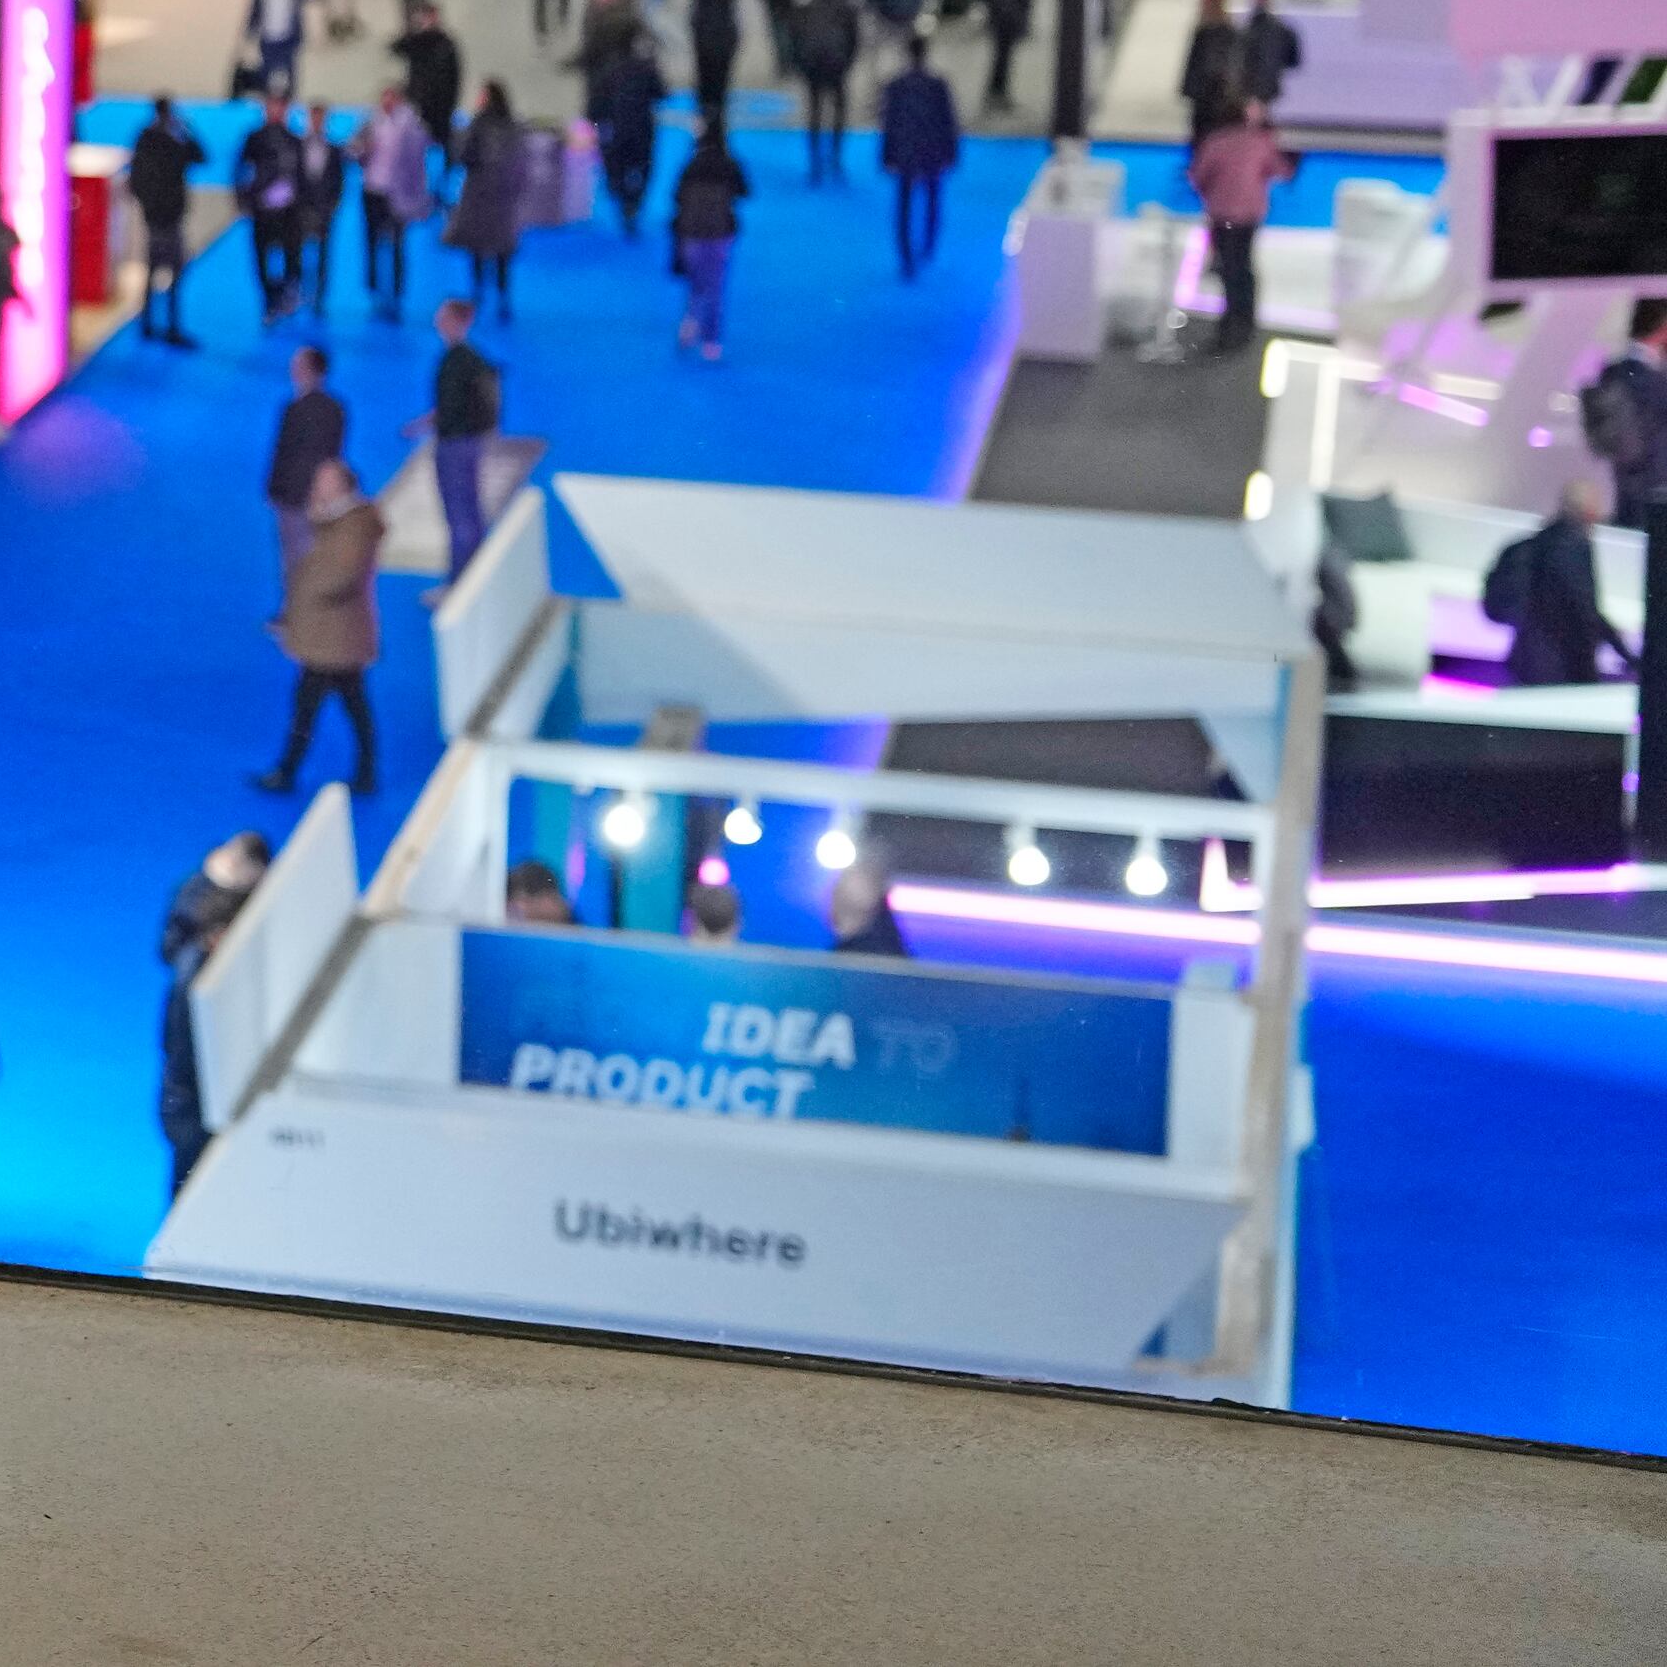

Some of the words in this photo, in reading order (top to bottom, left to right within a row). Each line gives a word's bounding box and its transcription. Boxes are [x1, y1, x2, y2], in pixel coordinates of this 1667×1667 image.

[703, 1001, 857, 1068] IDEA
[874, 1019, 958, 1075] TO
[510, 1043, 816, 1118] PRODUCT
[554, 1198, 807, 1268] Ubiwhere
